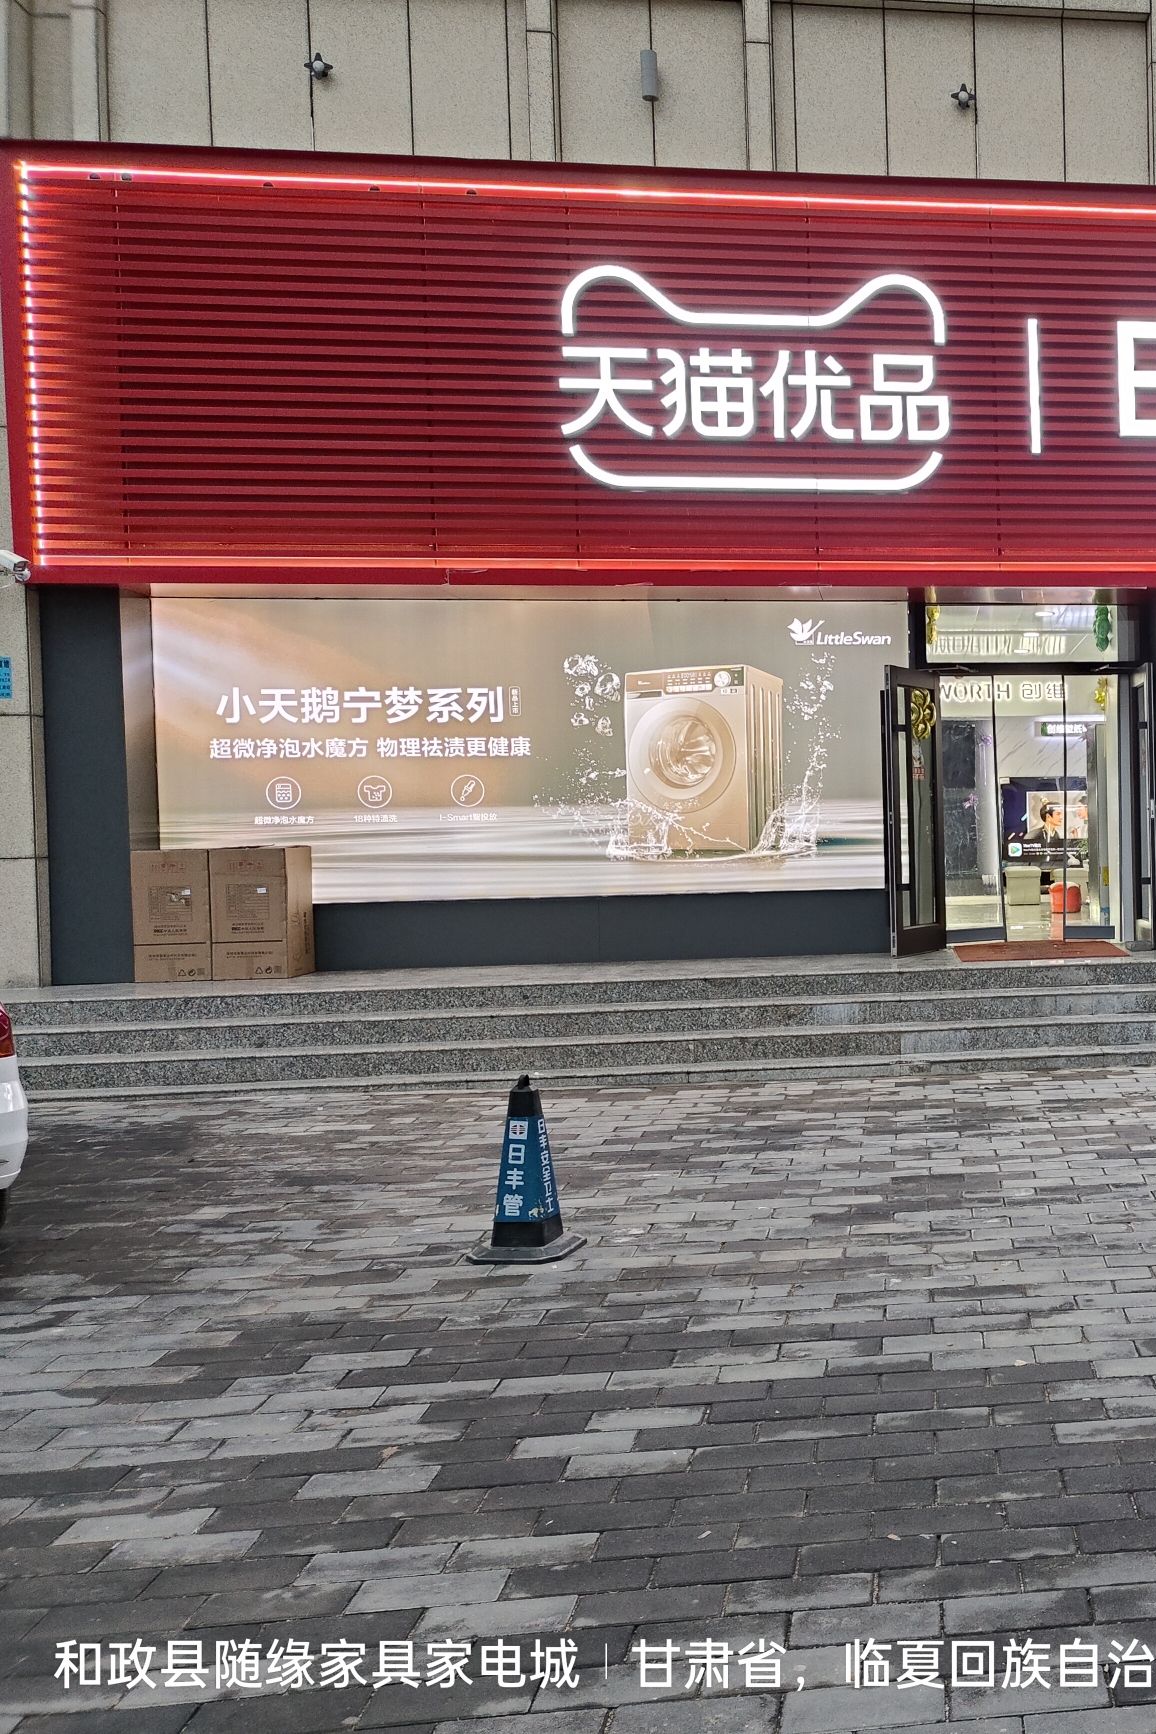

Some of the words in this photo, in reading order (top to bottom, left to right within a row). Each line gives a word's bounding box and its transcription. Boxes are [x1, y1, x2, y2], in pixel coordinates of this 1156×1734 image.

[559, 346, 950, 442] 天猫优品
[816, 631, 892, 646] LittleSwan
[216, 686, 504, 724] 小天鹅宁梦系列
[209, 738, 369, 759] 超微净泡水魔方
[376, 736, 531, 758] 物理祛渍更健康
[503, 1144, 526, 1217] 日丰管
